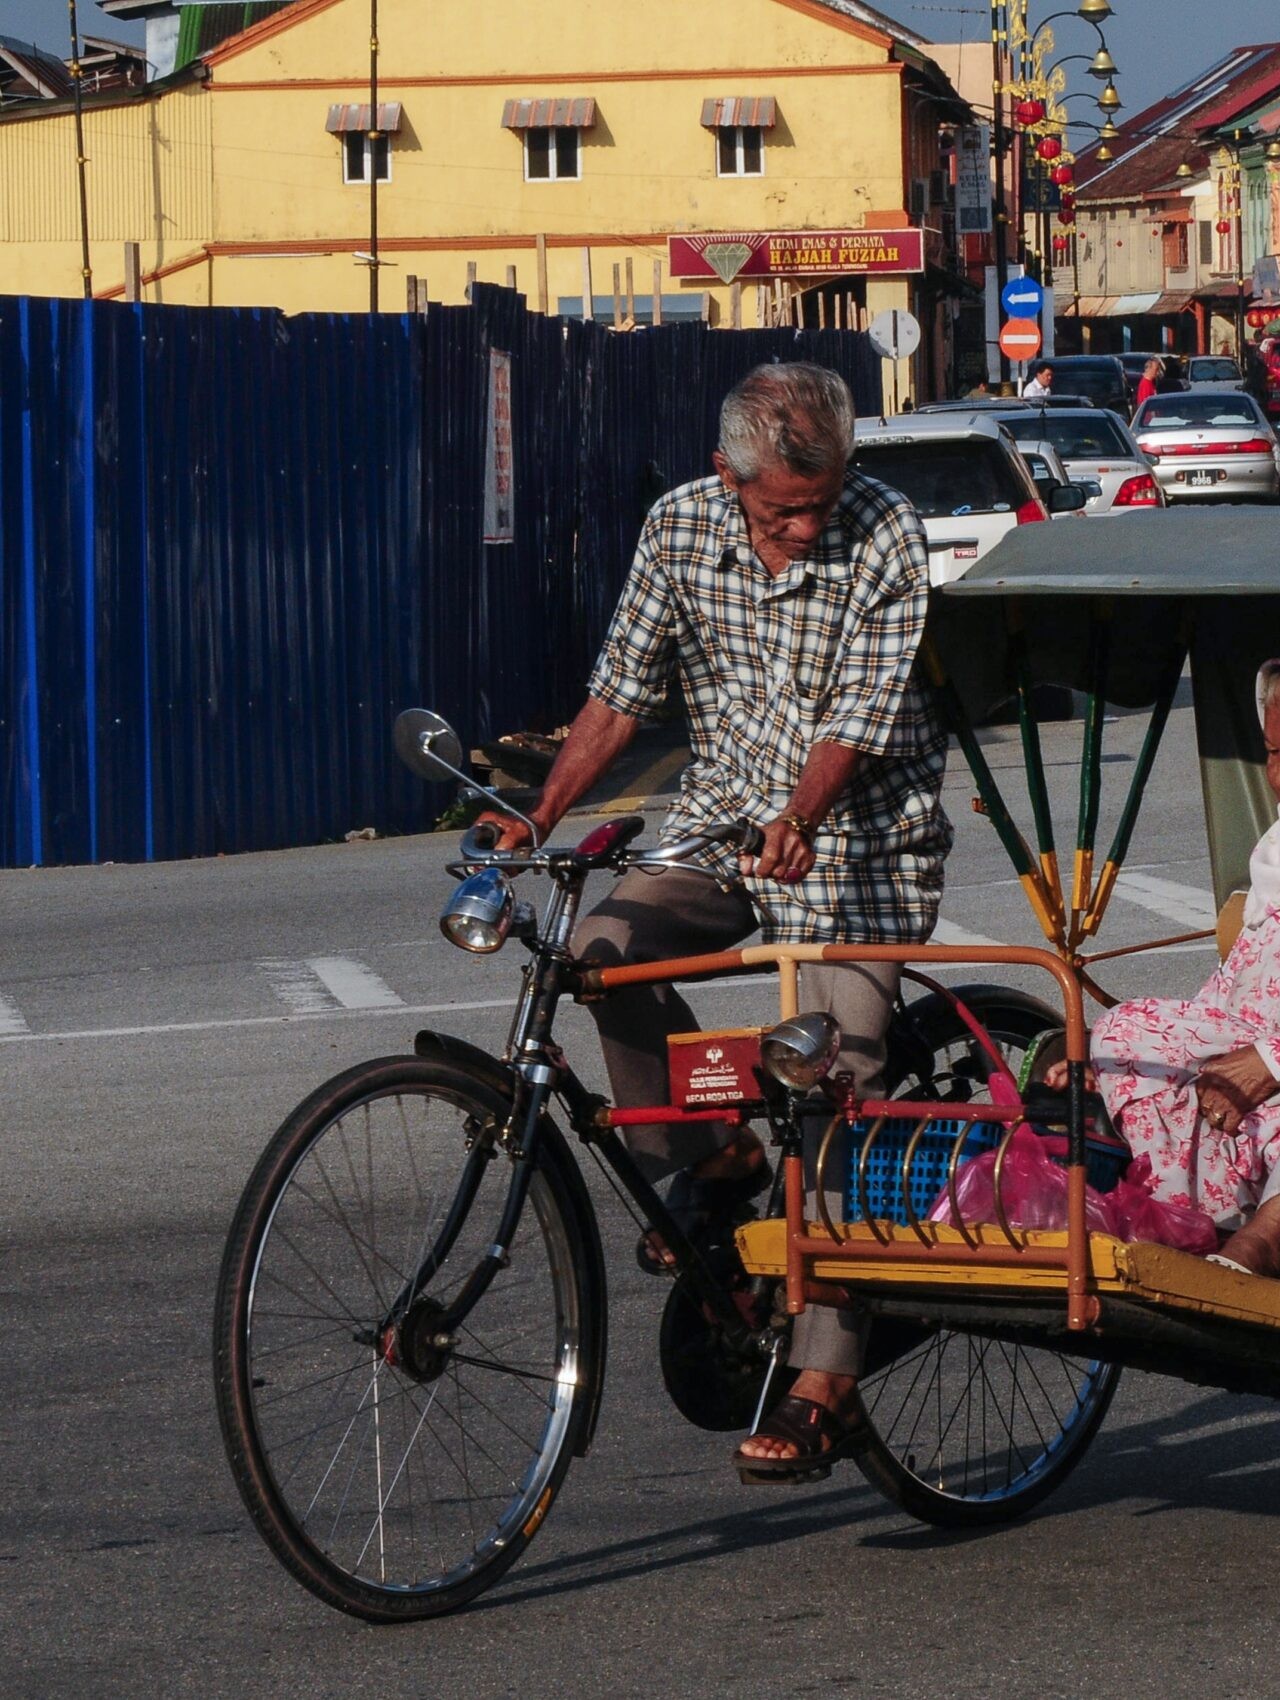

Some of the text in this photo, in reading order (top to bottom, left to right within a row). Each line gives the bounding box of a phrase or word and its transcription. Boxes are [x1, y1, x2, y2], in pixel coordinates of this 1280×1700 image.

[769, 236, 885, 250] KEDAI EMAS & PERMATA
[769, 248, 899, 265] HAJJAH FUZIAH
[685, 1094, 706, 1103] BECA
[727, 1091, 744, 1100] TIGA
